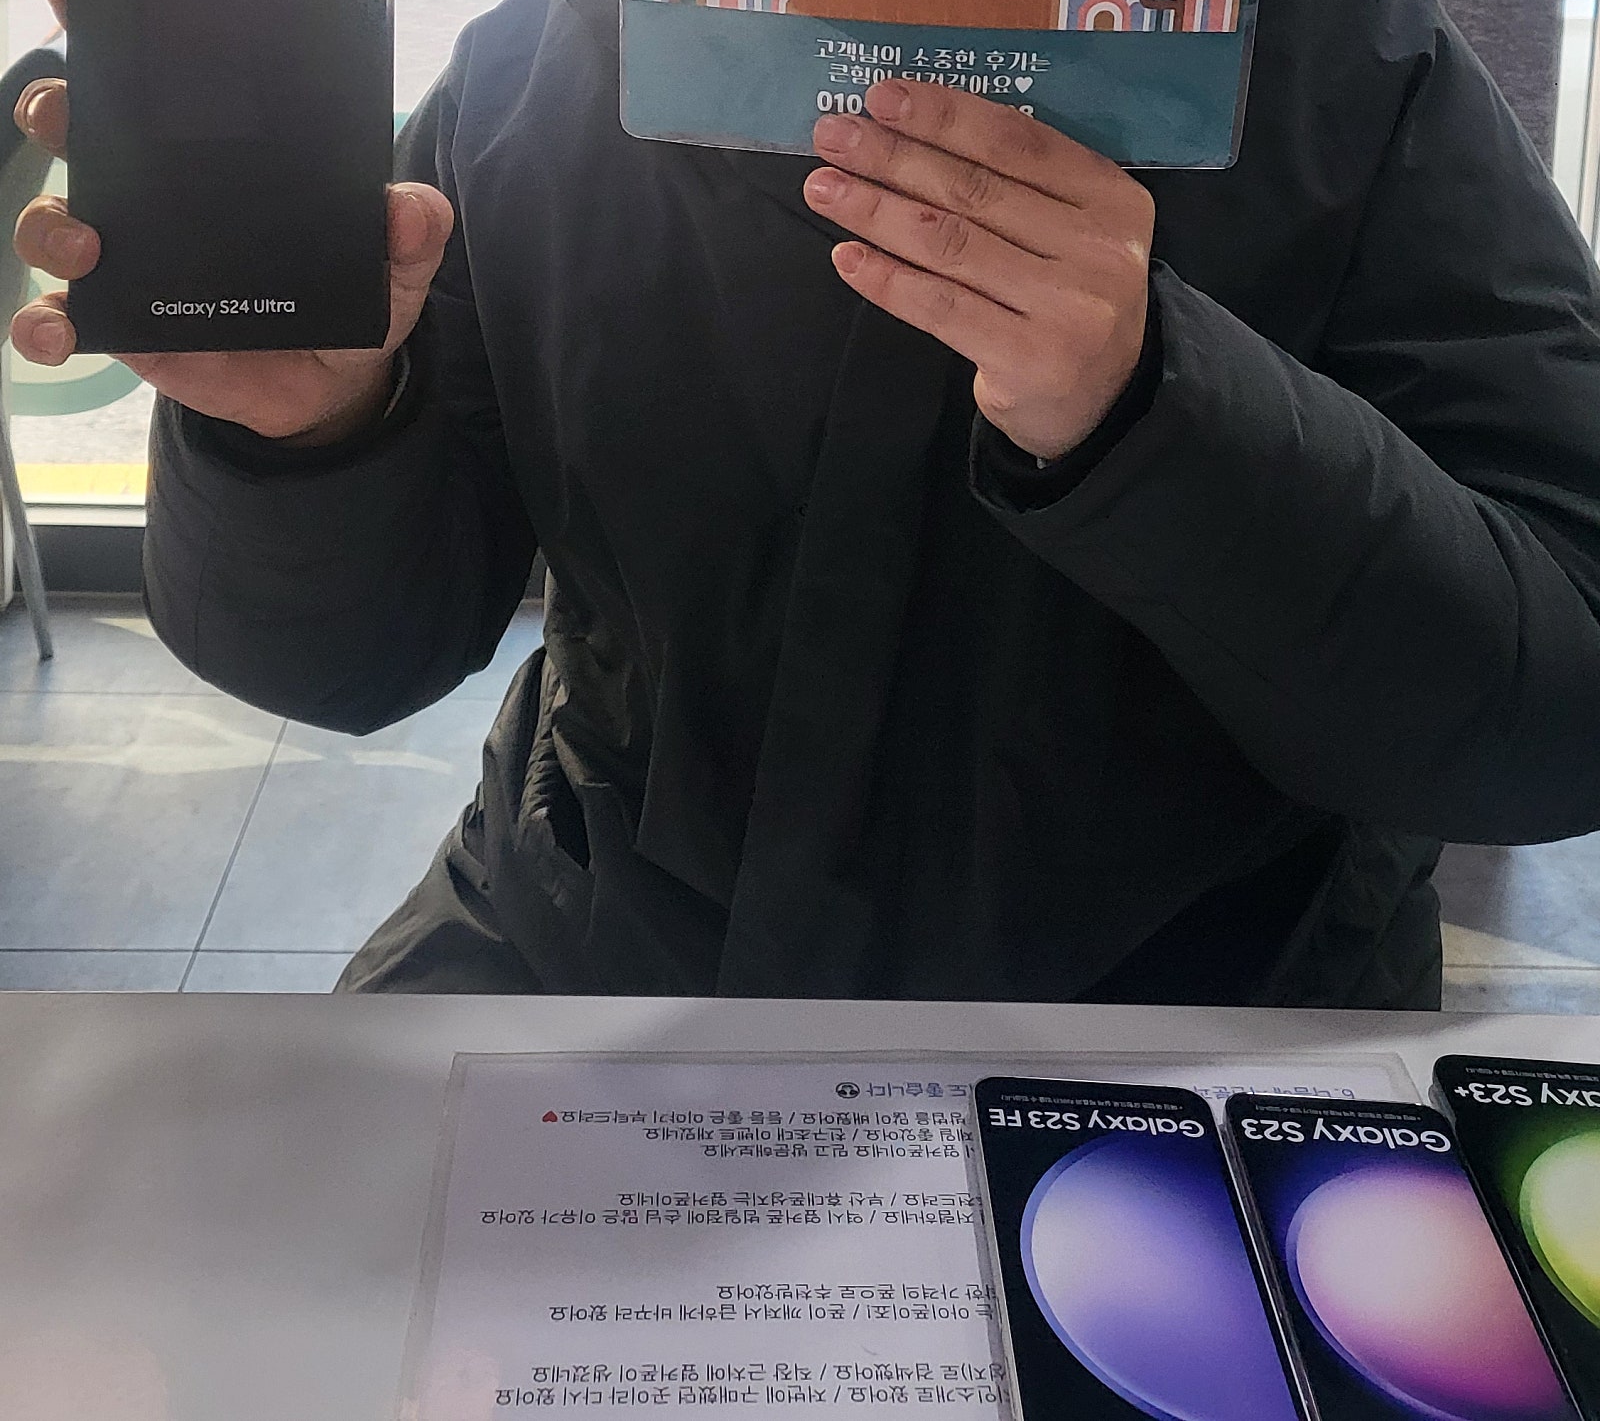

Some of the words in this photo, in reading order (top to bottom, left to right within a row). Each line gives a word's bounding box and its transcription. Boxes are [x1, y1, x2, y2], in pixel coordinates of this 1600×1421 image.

[813, 38, 901, 66] 고객님의
[909, 47, 977, 70] 소중한
[984, 50, 1051, 72] 후기는
[151, 300, 215, 318] Galaxy
[219, 299, 250, 314] S24
[254, 299, 296, 314] Ultra
[866, 1083, 943, 1098] 좋습니다
[1454, 1082, 1533, 1107] S23+
[560, 1110, 647, 1124] 부탁드려요
[654, 1110, 703, 1125] 이야기
[710, 1111, 743, 1125] 좋은
[748, 1111, 782, 1125] 등등
[801, 1112, 869, 1126] 배웠어요
[876, 1112, 908, 1126] 많이
[915, 1112, 966, 1126] 방법을
[988, 1108, 1022, 1127] FE
[1028, 1110, 1081, 1130] S23
[1088, 1109, 1204, 1138] Galaxy
[719, 1127, 770, 1141] 이벤트
[778, 1127, 846, 1142] 친구초대
[863, 1128, 933, 1142] 좋았어요
[940, 1128, 973, 1142] 제일
[1241, 1118, 1305, 1142] S23
[1313, 1117, 1451, 1154] Galaxy
[702, 1144, 807, 1158] 방문해보세요
[814, 1144, 848, 1159] 믿고
[854, 1144, 959, 1159] 옆커폰이네요
[618, 1192, 727, 1208] 옆커폰이네요
[733, 1192, 842, 1207] 휴대폰성지는
[849, 1192, 884, 1208] 부산
[480, 1210, 534, 1225] 있어요
[541, 1210, 595, 1225] 이유가
[602, 1210, 638, 1225] 많은
[646, 1210, 681, 1225] 손님
[688, 1210, 759, 1225] 범일점에
[766, 1210, 821, 1225] 옆커폰
[828, 1210, 863, 1225] 역시
[881, 1210, 974, 1225] 저렴하네요
[717, 1284, 832, 1301] 추천받았어요
[838, 1284, 895, 1301] 폰으로
[903, 1283, 959, 1301] 가격의
[549, 1305, 607, 1322] 왔어요
[616, 1304, 671, 1322] 바꾸러
[680, 1304, 737, 1322] 급하게
[745, 1304, 801, 1321] 깨져서
[809, 1304, 845, 1321] 폰이
[867, 1304, 969, 1322] 아이폰이죠!
[532, 1364, 612, 1384] 생겼네요
[620, 1364, 698, 1384] 옆커폰이
[707, 1364, 766, 1383] 근처에
[773, 1363, 811, 1382] 직장
[833, 1363, 934, 1382] 검색했어요
[496, 1388, 555, 1407] 왔어요
[563, 1387, 602, 1407] 다시
[609, 1387, 670, 1406] 곳이라
[679, 1385, 759, 1405] 구매했던
[767, 1385, 826, 1404] 저번에
[848, 1385, 908, 1404] 왔어요
